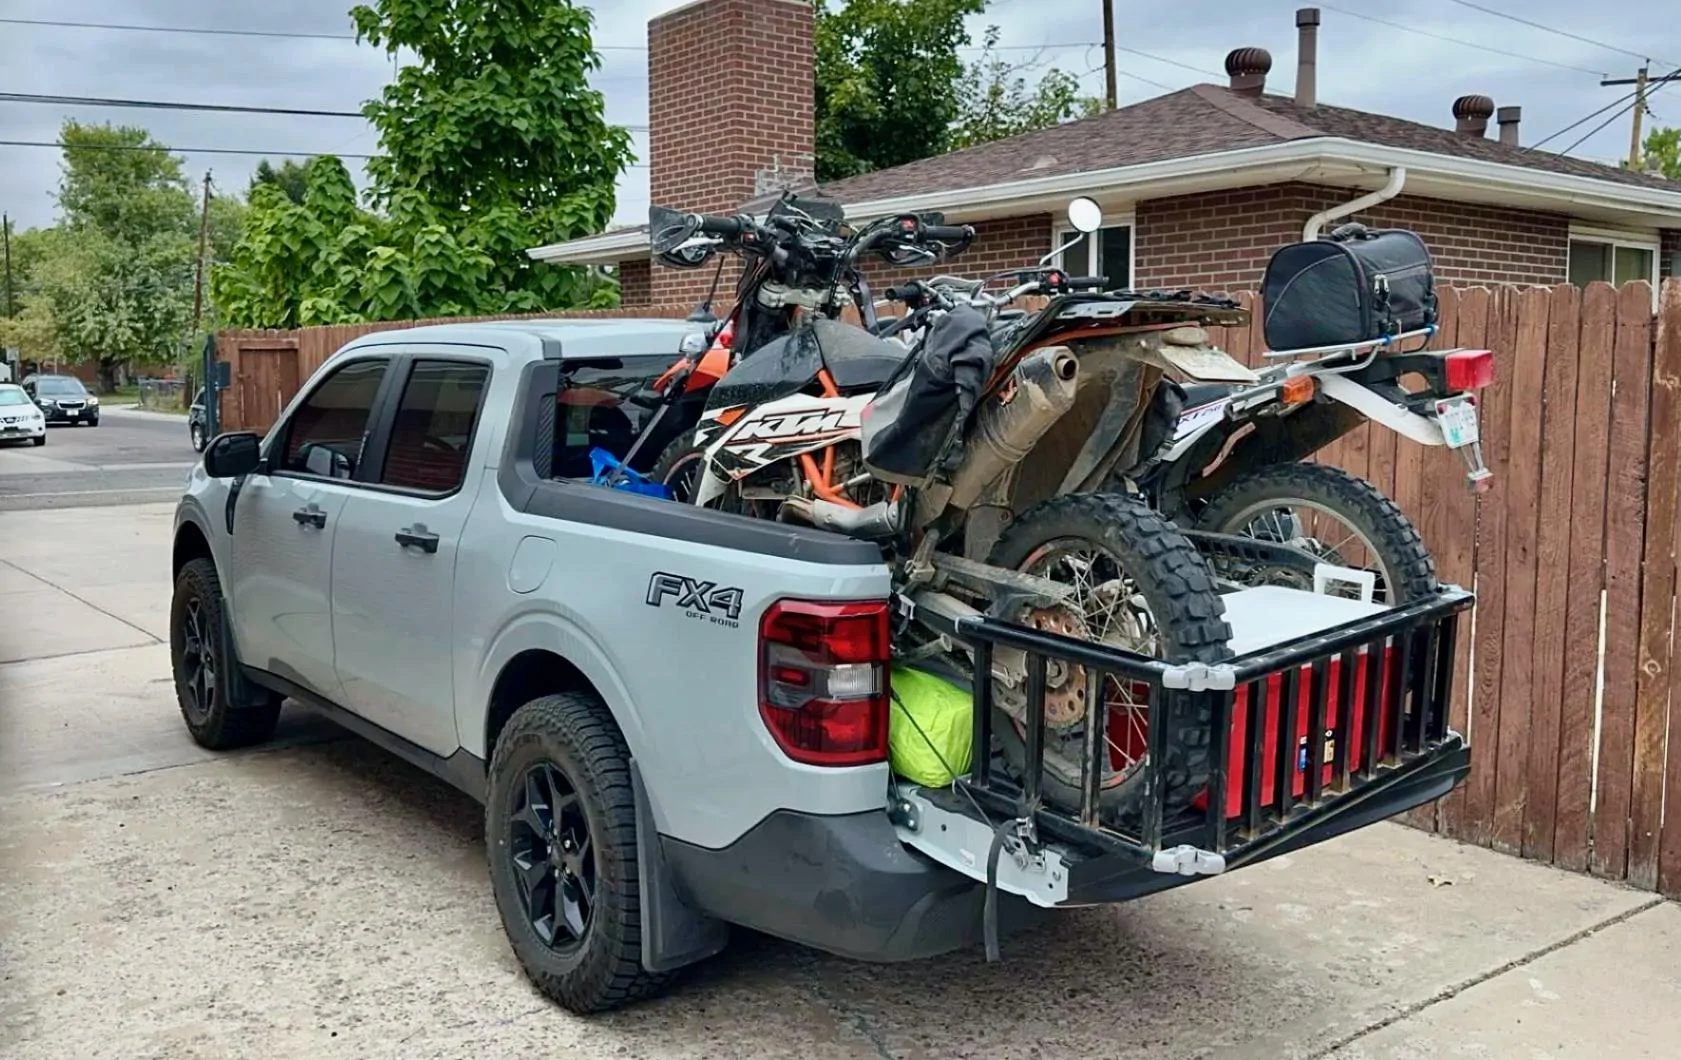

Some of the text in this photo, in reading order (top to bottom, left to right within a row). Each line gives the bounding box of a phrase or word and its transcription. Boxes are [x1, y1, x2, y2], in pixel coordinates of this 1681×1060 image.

[729, 408, 846, 442] KTM
[646, 571, 744, 620] FX4
[686, 610, 739, 629] OFF ROAD
